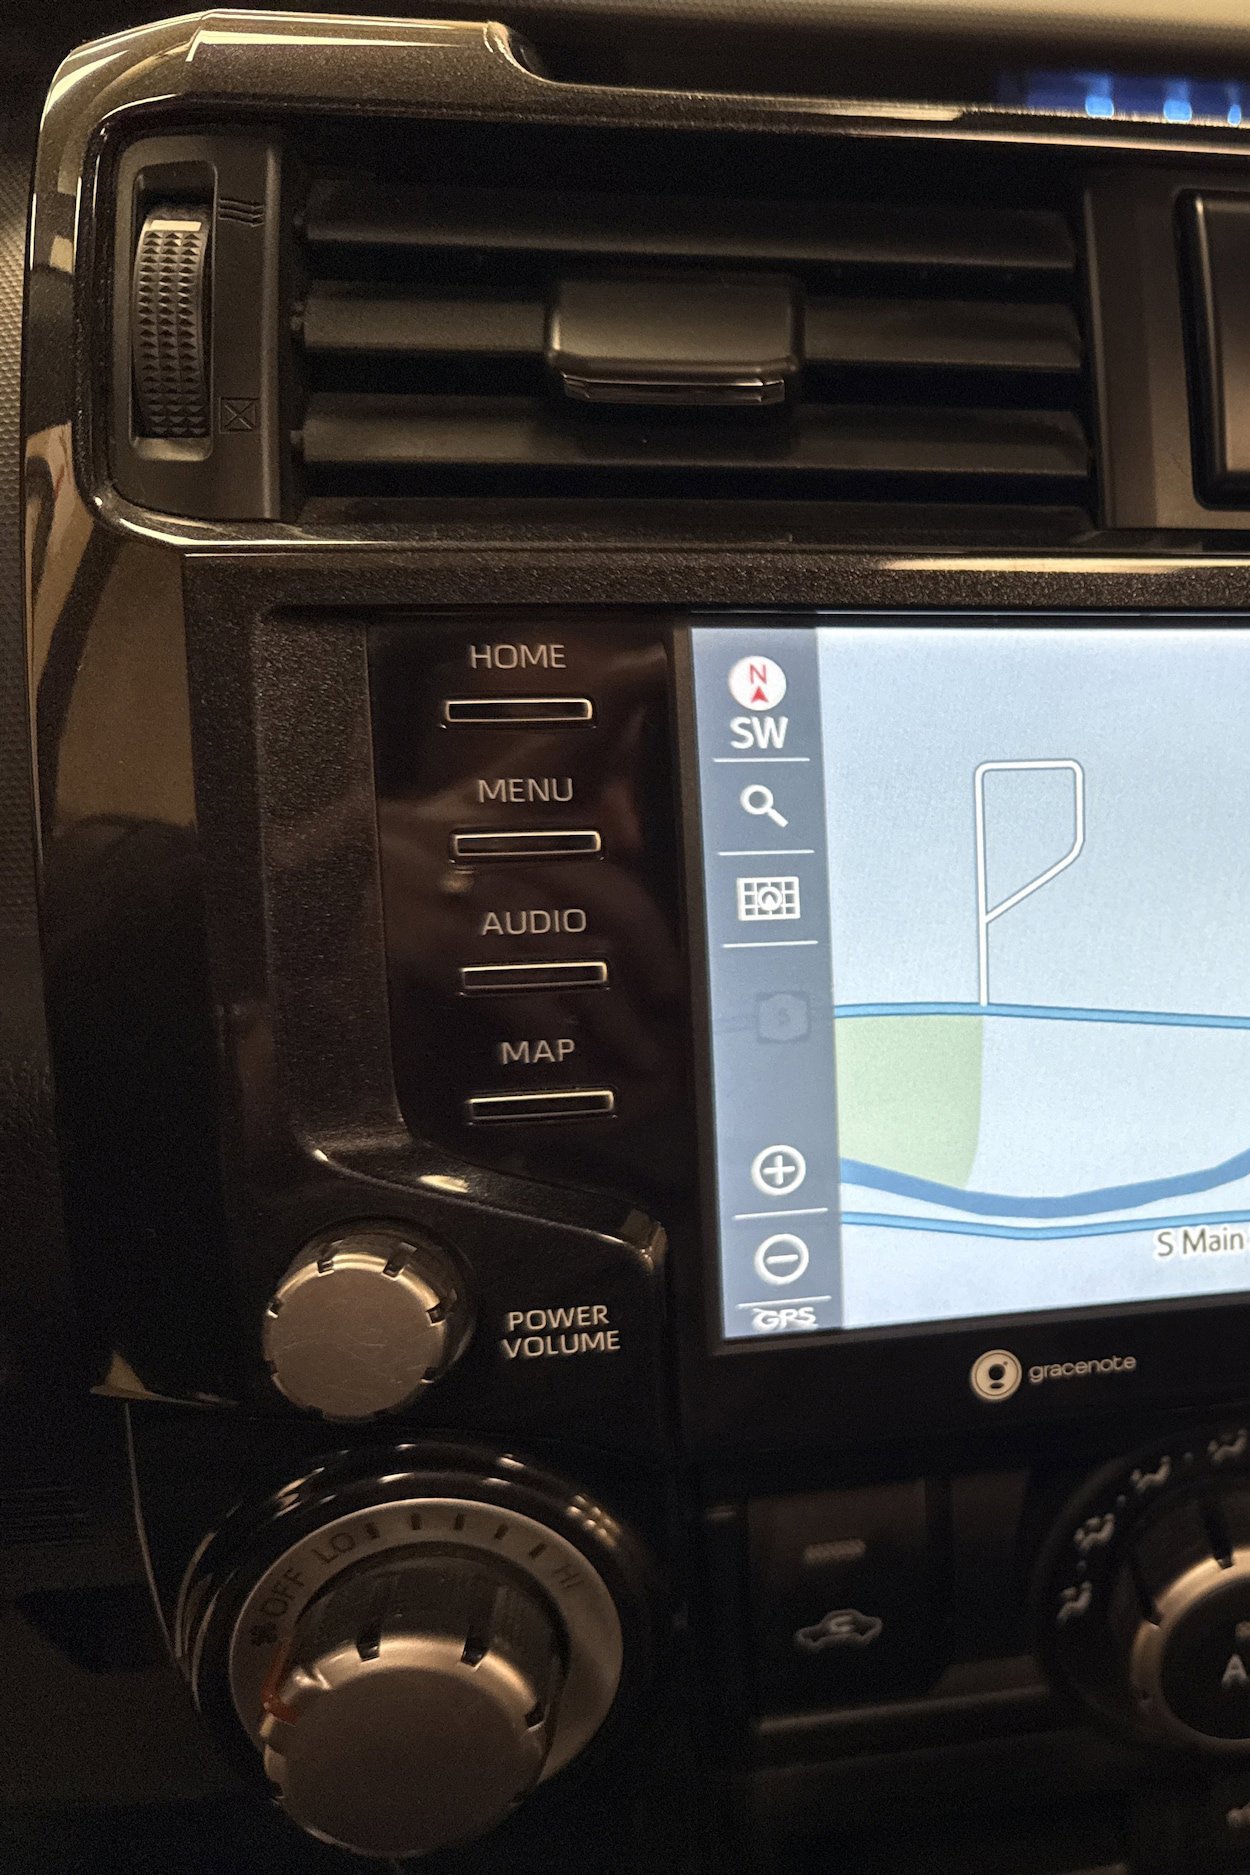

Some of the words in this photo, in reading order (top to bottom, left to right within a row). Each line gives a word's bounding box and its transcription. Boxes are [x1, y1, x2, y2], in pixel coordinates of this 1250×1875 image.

[469, 644, 567, 669] HOME
[748, 663, 767, 685] N
[729, 715, 789, 749] SW
[478, 777, 575, 803] MENU
[480, 907, 588, 936] AUDIO
[500, 1038, 576, 1065] MAP
[1157, 1231, 1174, 1257] S
[1182, 1226, 1244, 1254] Main
[507, 1304, 611, 1332] POWER
[752, 1306, 819, 1332] GPS
[502, 1330, 621, 1359] VOLUME
[1029, 1355, 1137, 1383] gracenote
[261, 1568, 305, 1618] OFF
[311, 1532, 356, 1565] LO
[553, 1561, 586, 1590] HI
